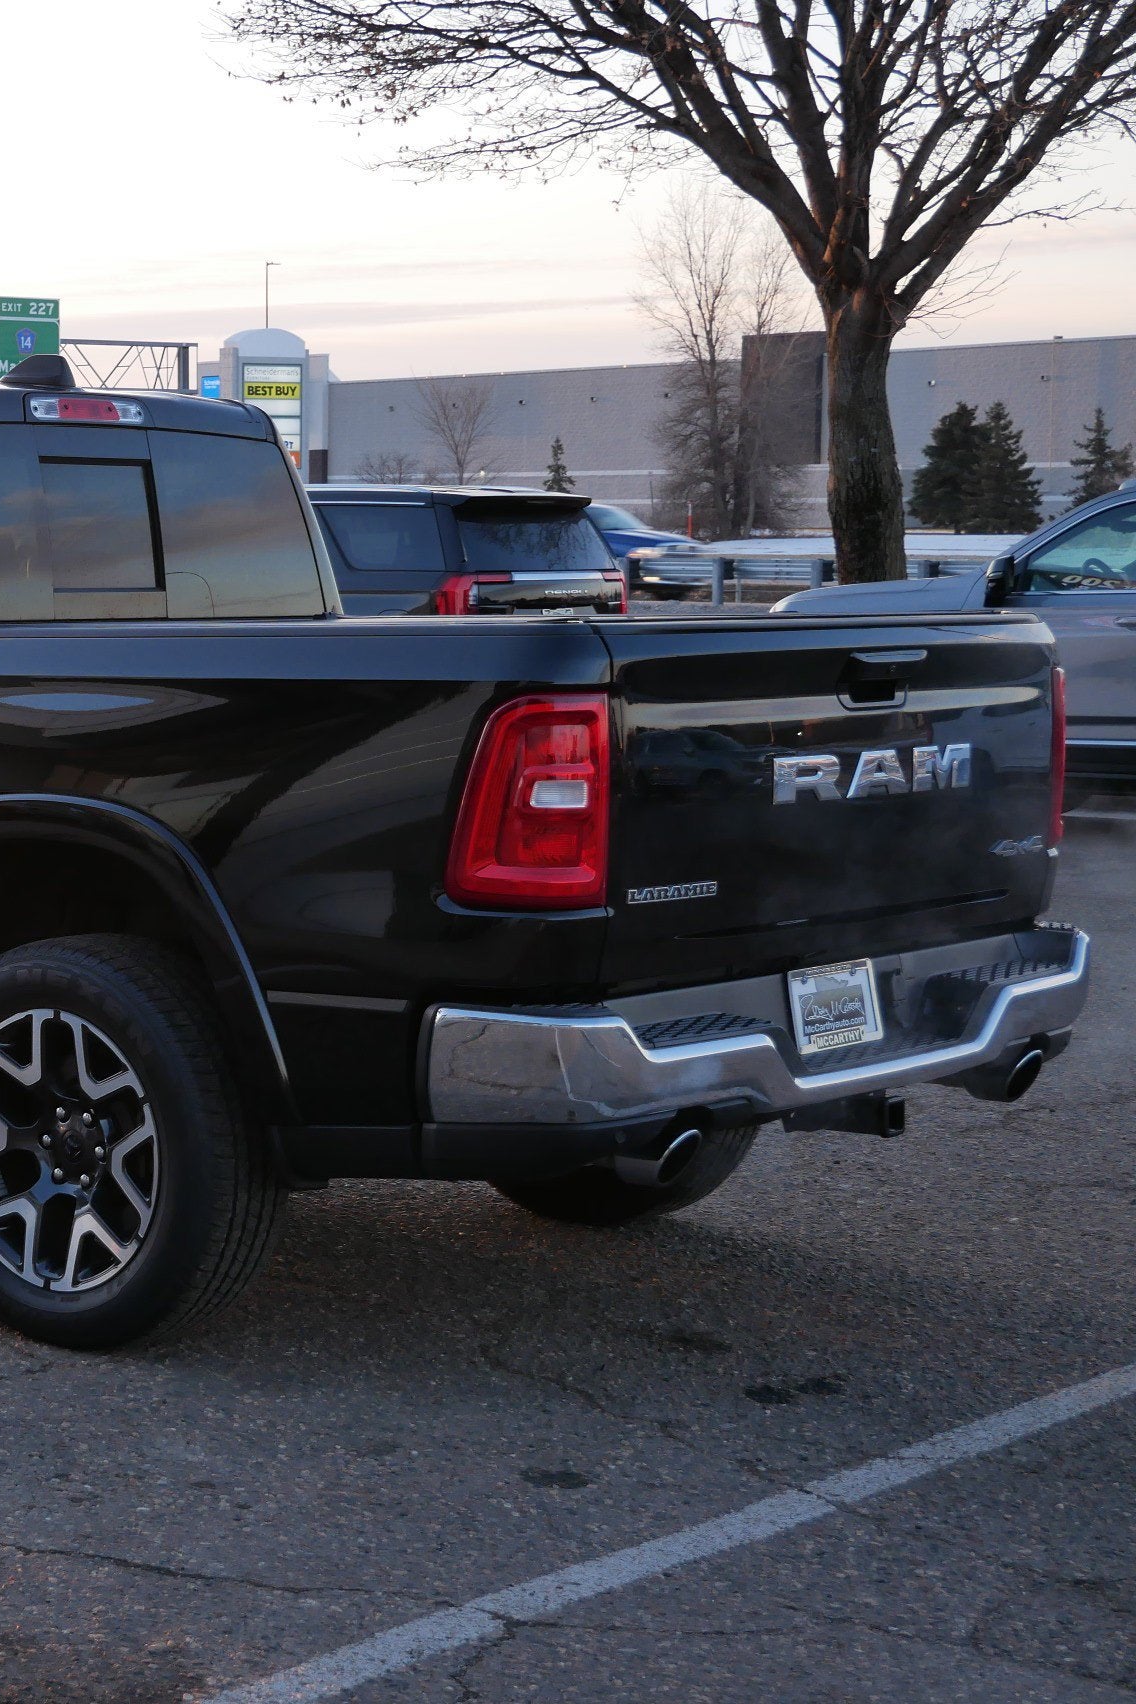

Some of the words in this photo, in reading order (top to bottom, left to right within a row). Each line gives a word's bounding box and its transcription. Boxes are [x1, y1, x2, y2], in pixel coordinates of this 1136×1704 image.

[1, 303, 23, 312] EXIT
[29, 302, 54, 315] 227
[20, 336, 32, 349] 14
[247, 386, 274, 396] BEST
[275, 386, 297, 396] BUY
[773, 743, 971, 806] RAM
[628, 881, 718, 904] LARAMIE
[804, 1017, 865, 1034] McCarthyauto.com
[817, 1030, 860, 1048] MCCARTHY
